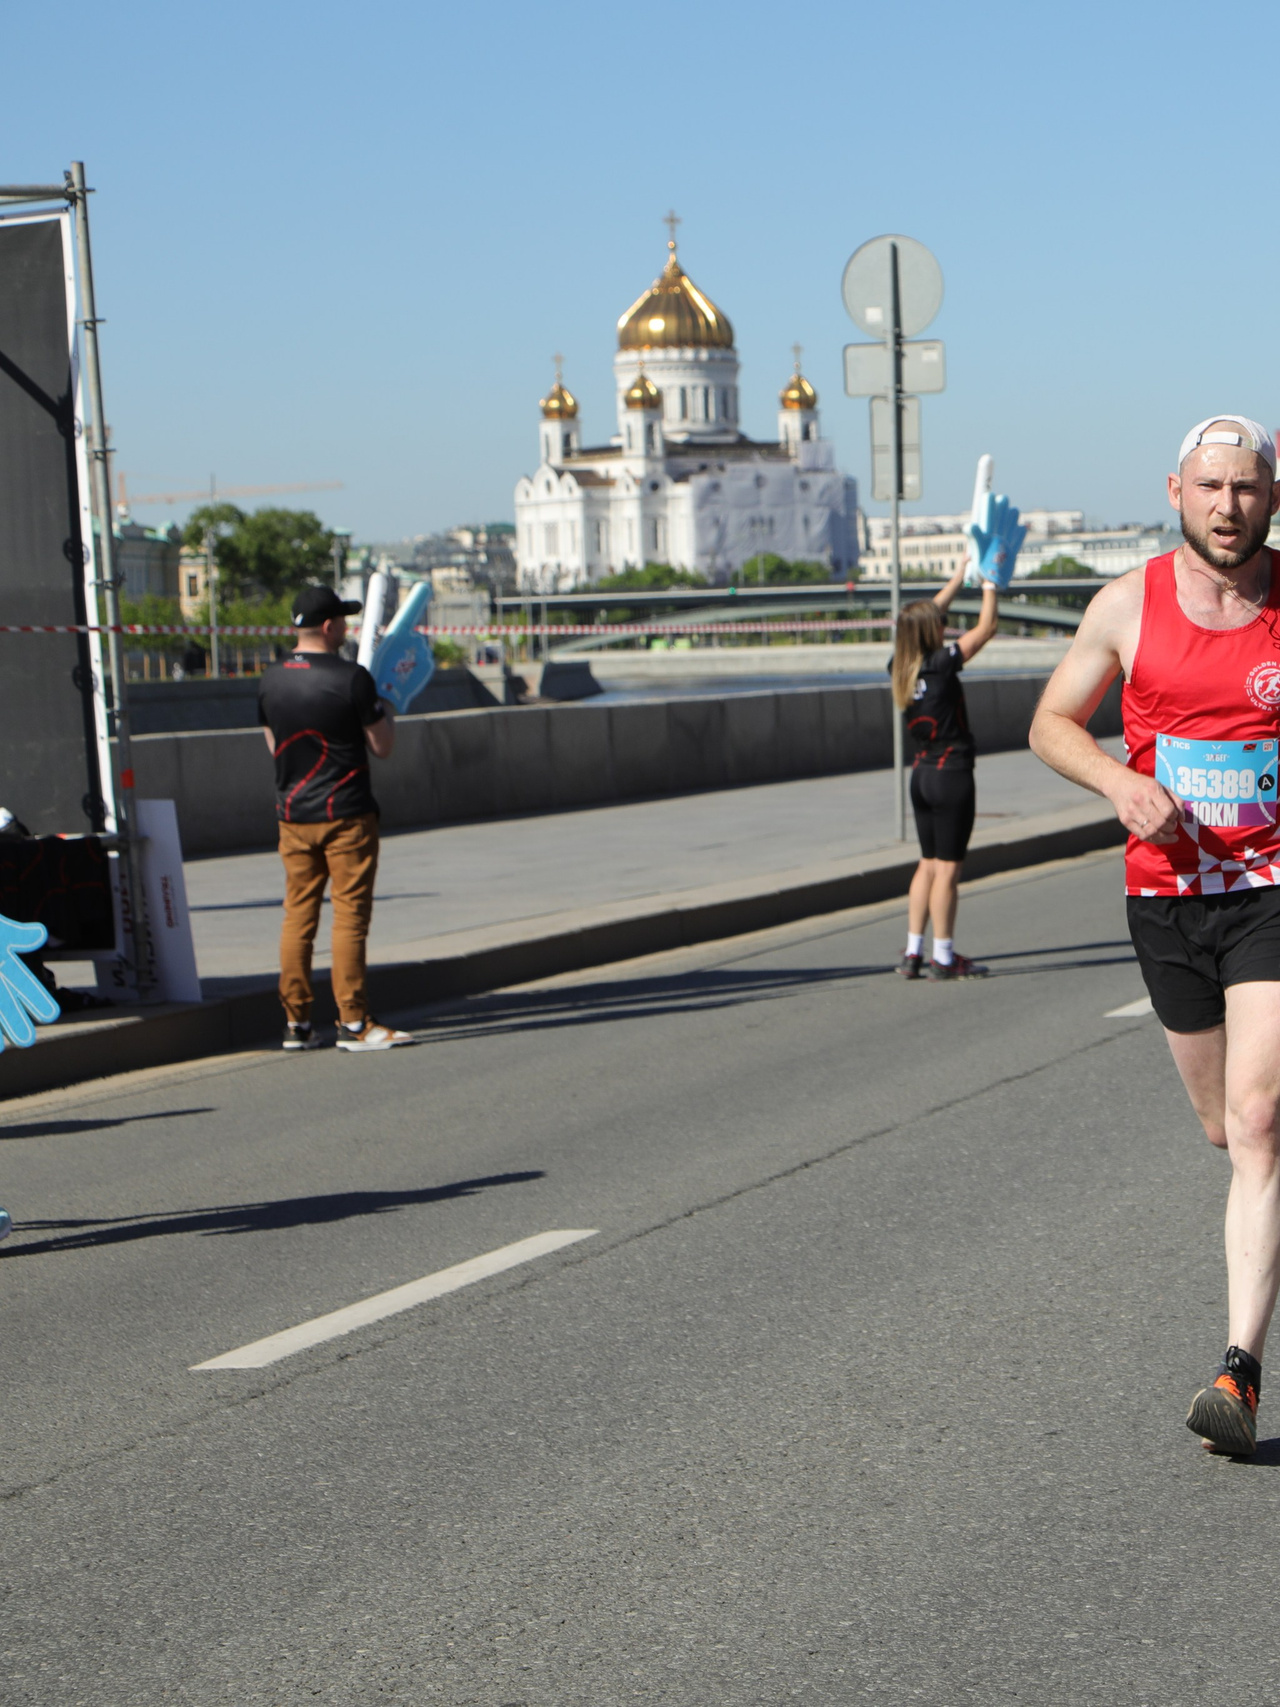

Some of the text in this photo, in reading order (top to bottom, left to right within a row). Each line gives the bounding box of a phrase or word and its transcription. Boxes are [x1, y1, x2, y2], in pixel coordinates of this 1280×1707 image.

[1249, 660, 1277, 677] GOLDEN
[1250, 696, 1273, 712] ULTRA
[1172, 740, 1191, 750] ПСБ
[1176, 766, 1272, 799] 35389 A
